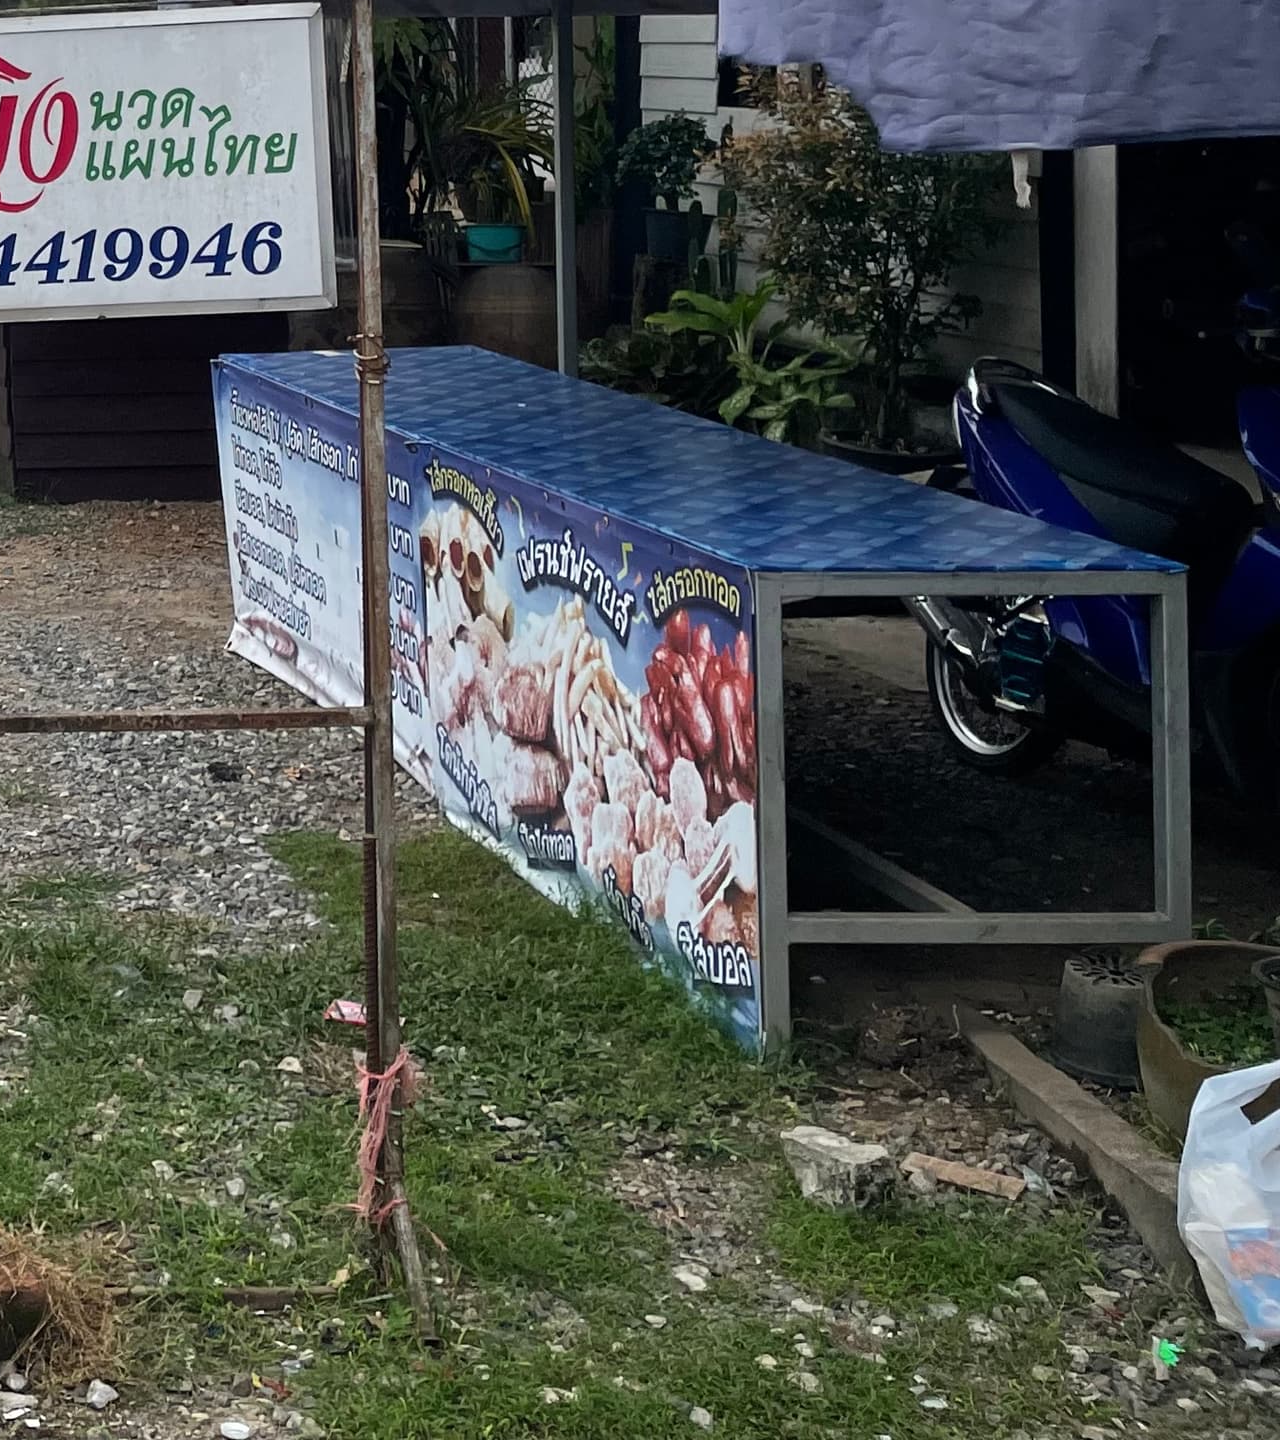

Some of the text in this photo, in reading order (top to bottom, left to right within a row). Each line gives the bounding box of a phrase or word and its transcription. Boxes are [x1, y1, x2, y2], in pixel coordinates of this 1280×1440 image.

[90, 87, 192, 132] นวด
[85, 105, 298, 182] แผนไทย
[345, 444, 360, 482] ไก่
[387, 472, 411, 507] บาท
[390, 523, 414, 559] บาท
[392, 573, 417, 612] บาท
[517, 528, 636, 638] เฟรนช์ฟรายส์
[647, 568, 742, 619] ไส้กรอกทอด
[396, 624, 420, 664] บาท
[400, 672, 423, 718] บาท
